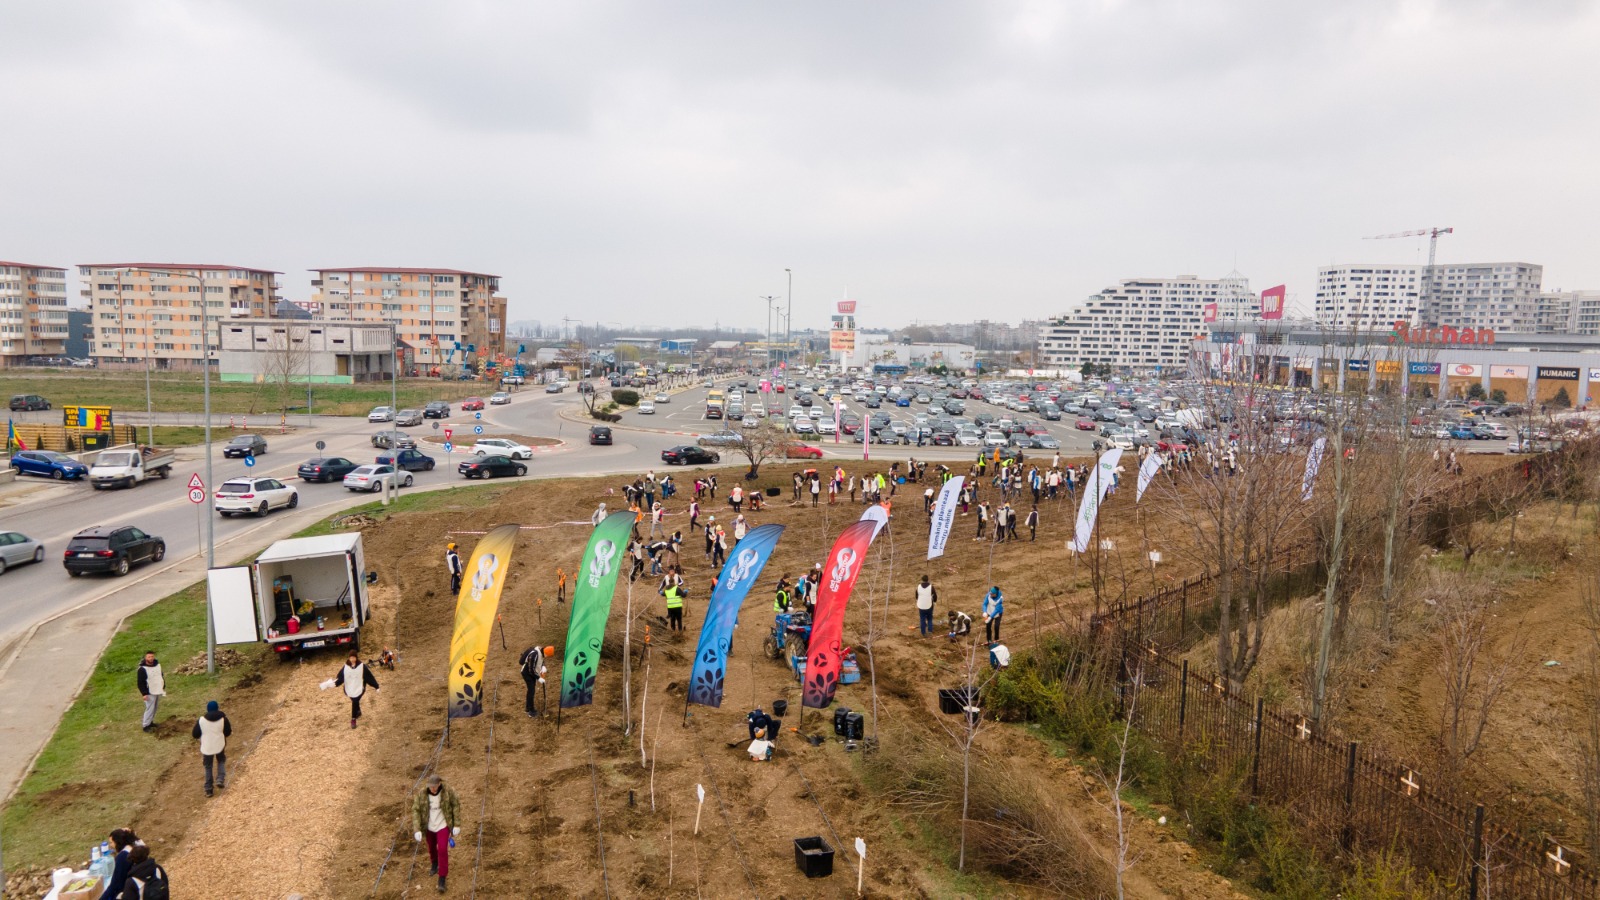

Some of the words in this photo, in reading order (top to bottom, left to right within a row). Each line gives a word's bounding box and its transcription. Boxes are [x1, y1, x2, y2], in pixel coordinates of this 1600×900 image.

[1389, 320, 1495, 345] Auchan
[933, 521, 942, 549] România
[939, 490, 950, 520] plantează
